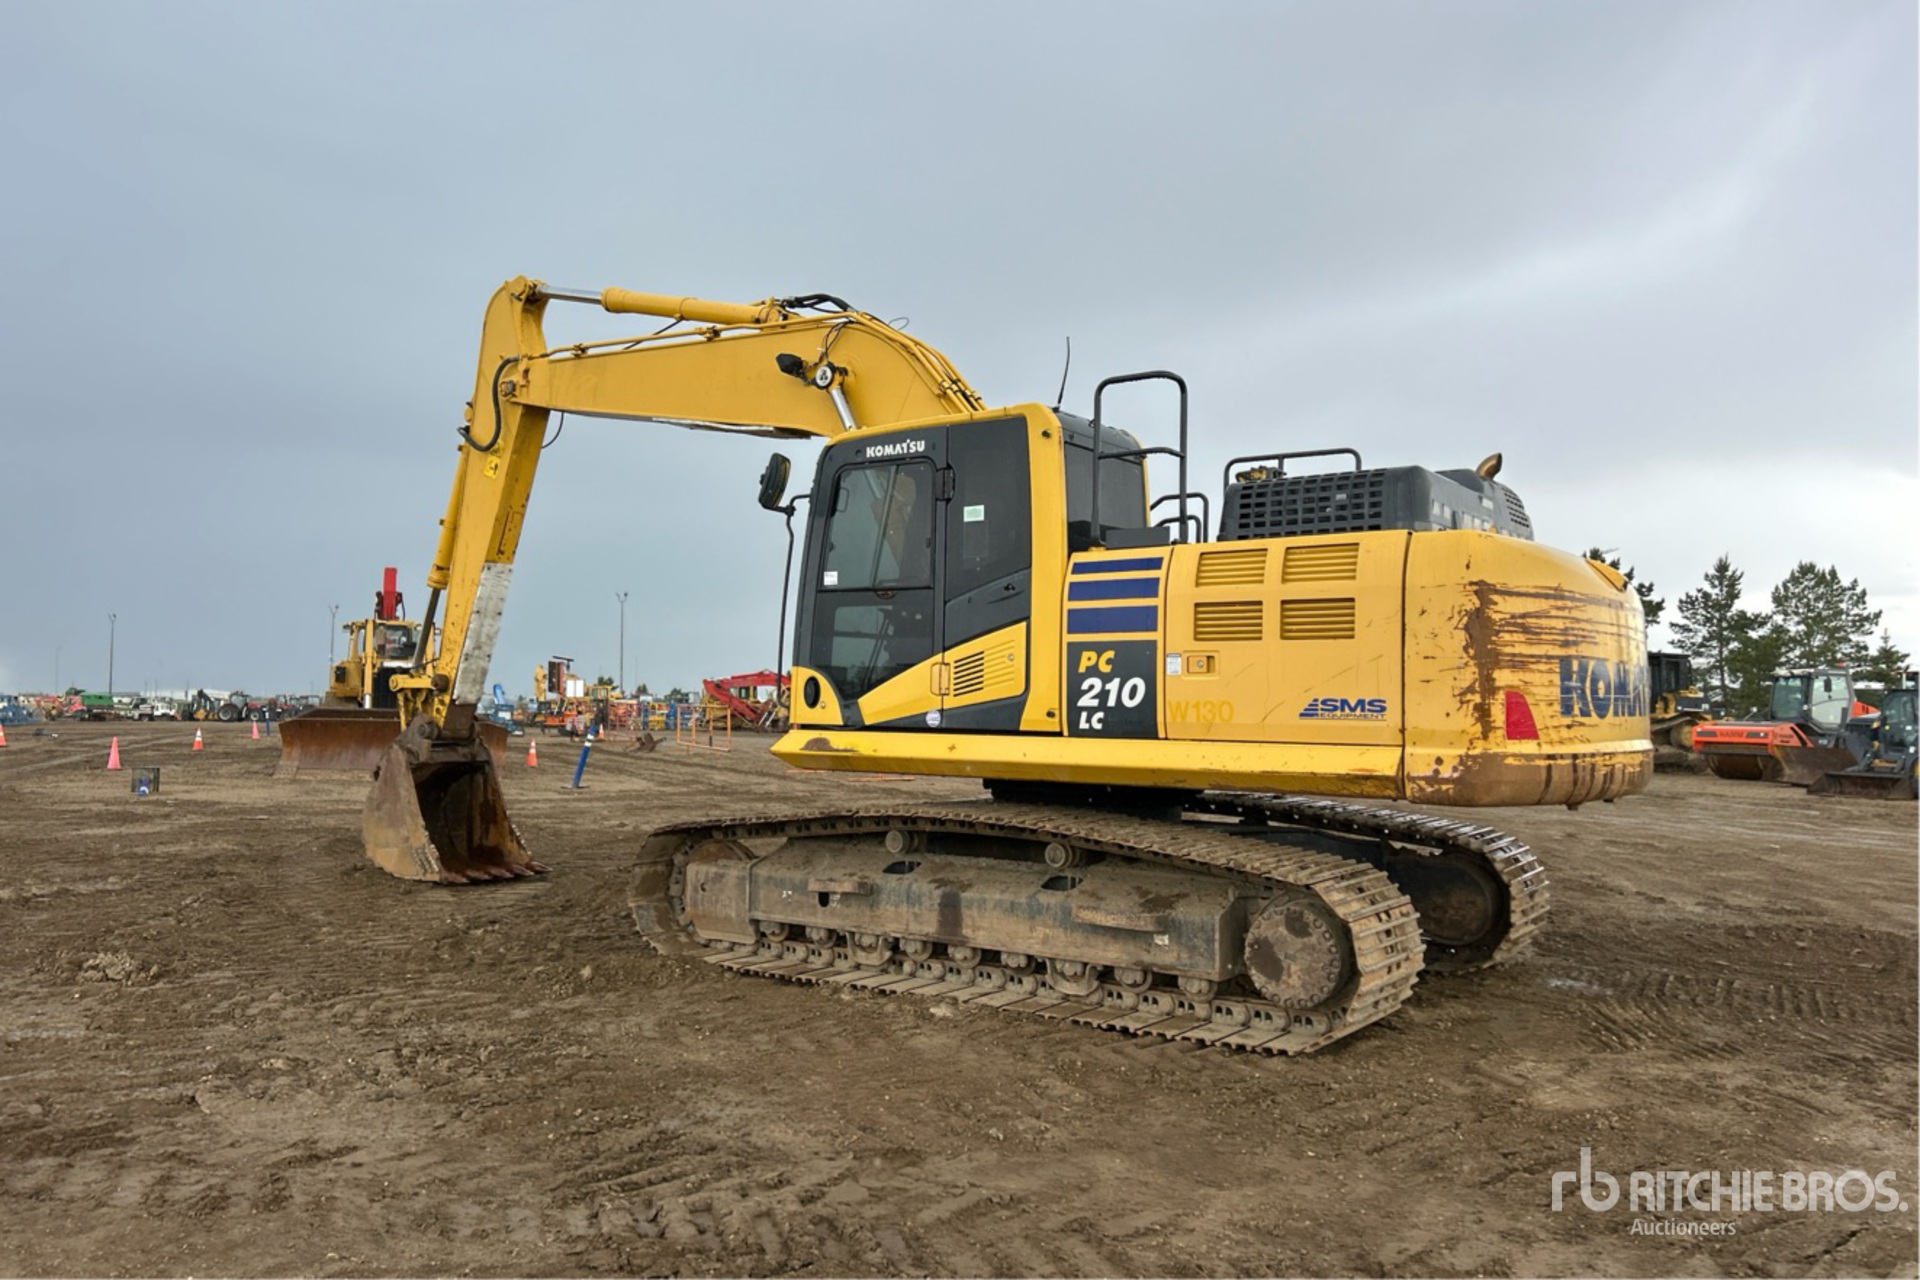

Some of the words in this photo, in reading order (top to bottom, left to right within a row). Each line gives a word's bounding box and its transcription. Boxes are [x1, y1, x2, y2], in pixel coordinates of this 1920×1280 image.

[866, 439, 925, 458] KOMATSU
[1077, 650, 1115, 673] PC
[1077, 677, 1146, 708] 210
[1167, 701, 1234, 723] W130
[1320, 698, 1387, 713] SMS
[1078, 711, 1105, 730] LC
